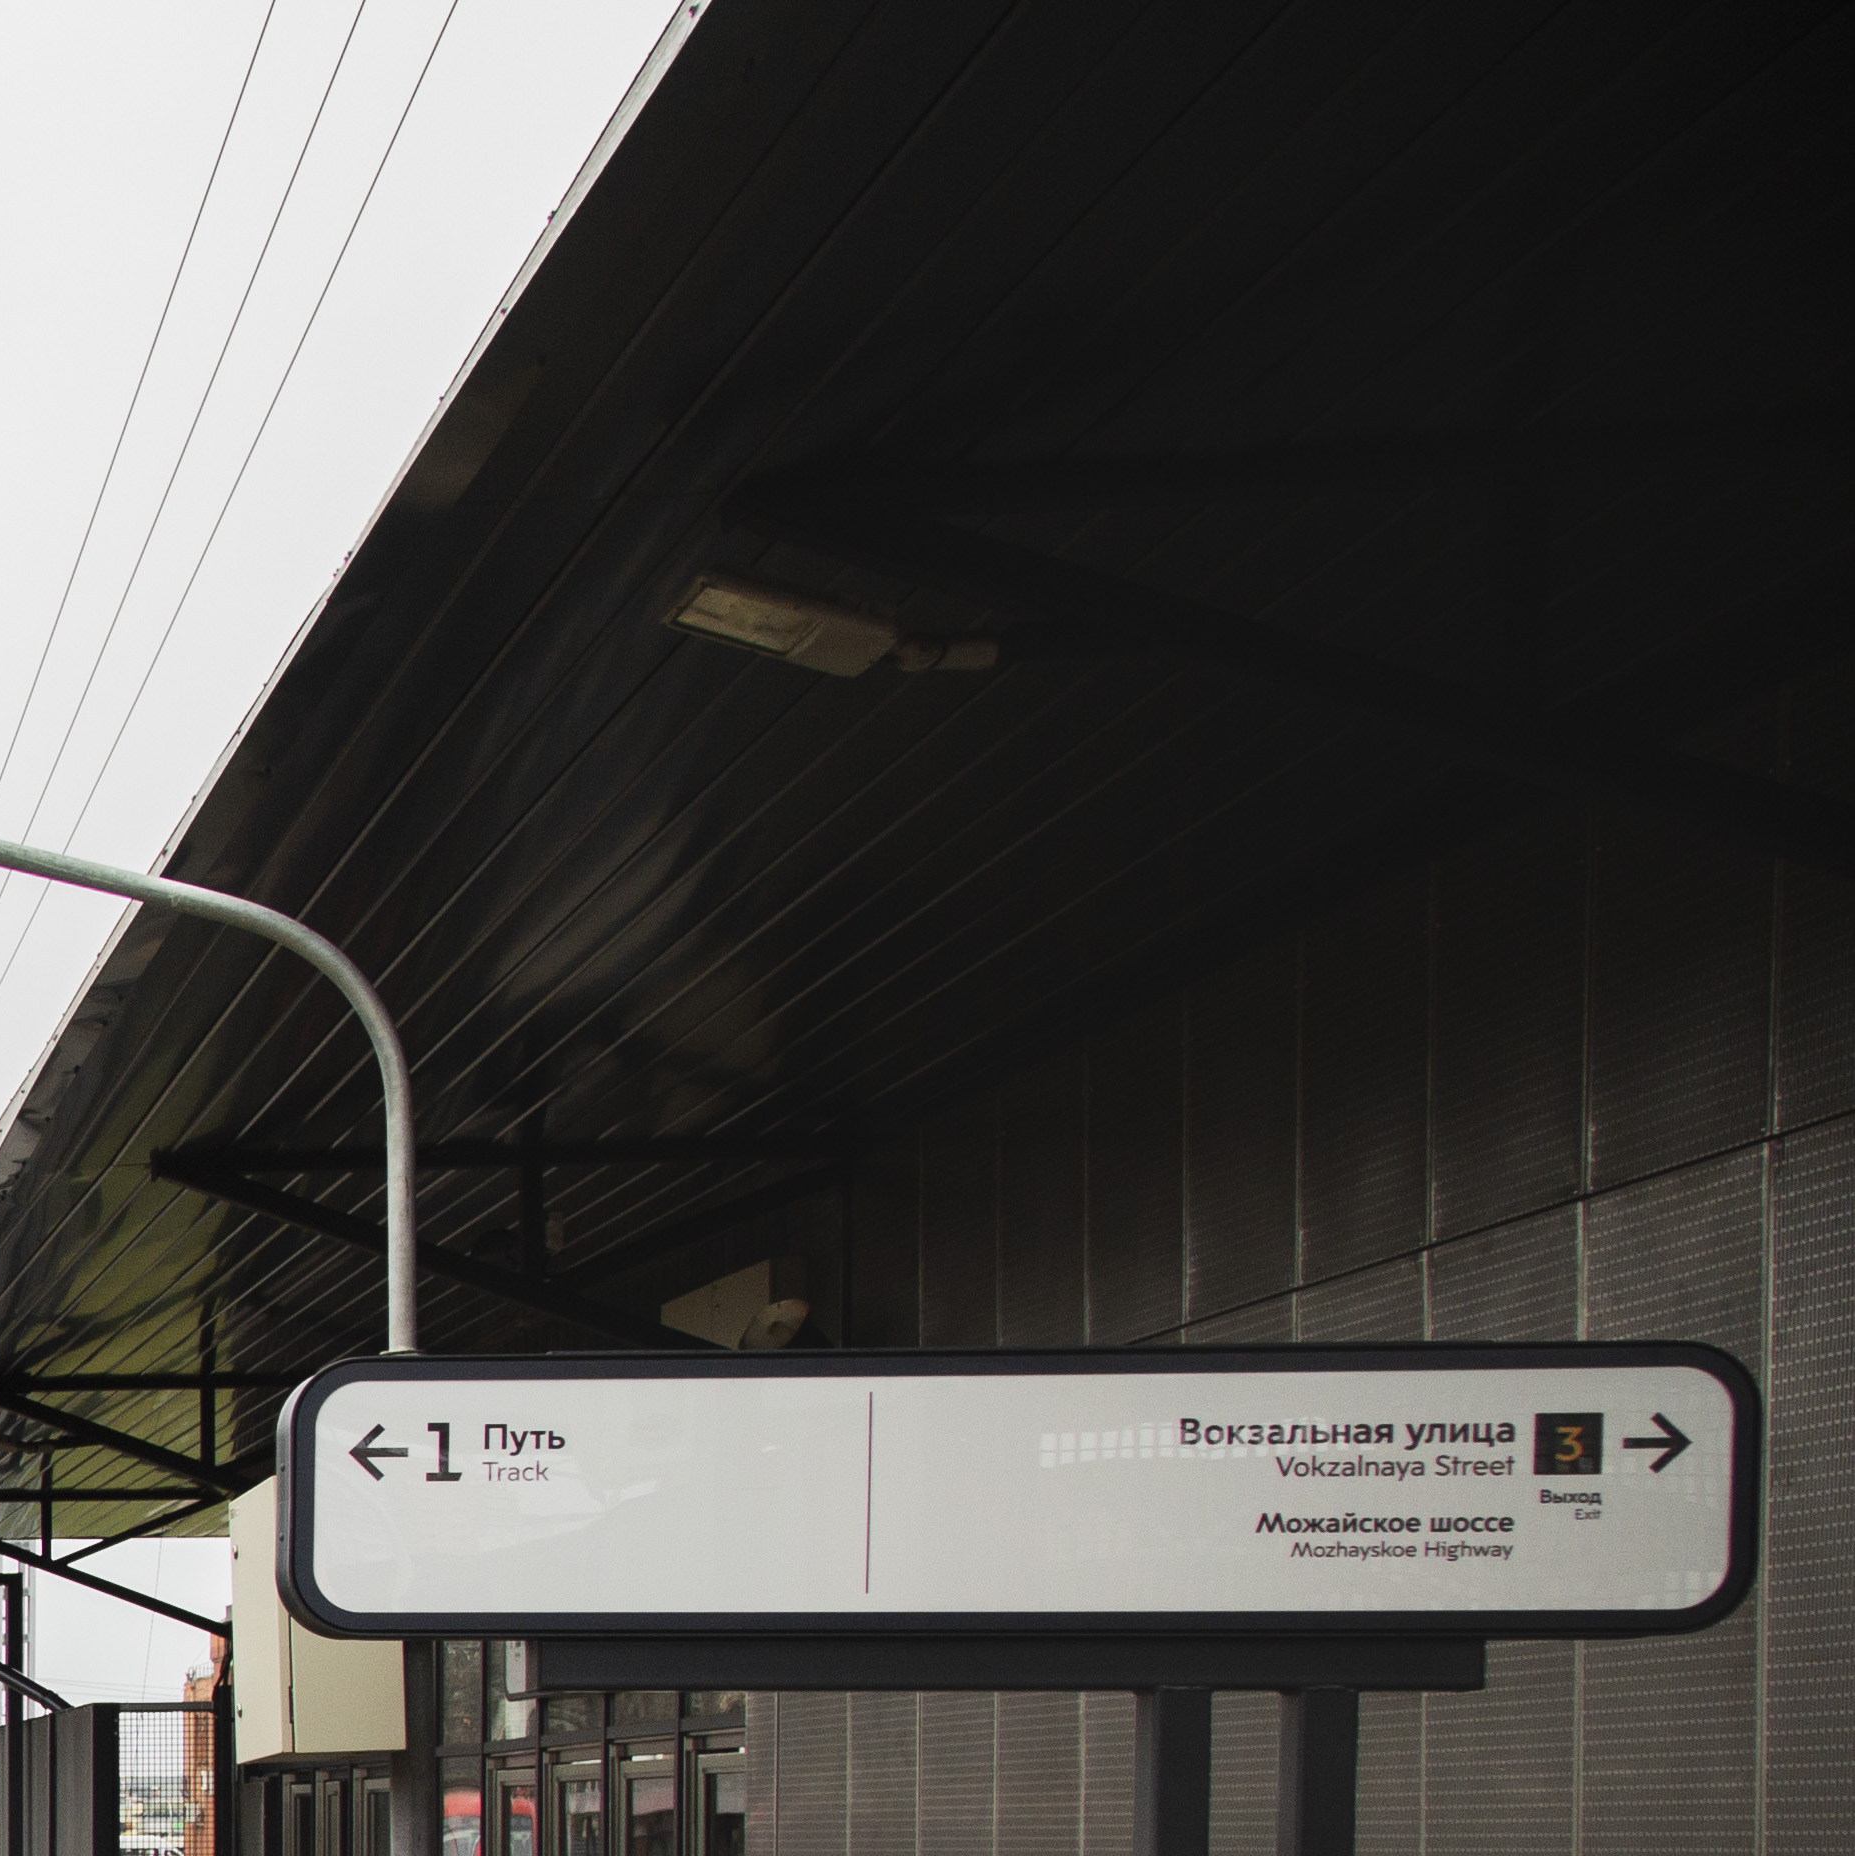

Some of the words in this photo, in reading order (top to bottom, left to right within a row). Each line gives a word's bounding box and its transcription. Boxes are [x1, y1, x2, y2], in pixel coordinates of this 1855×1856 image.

[484, 1423, 566, 1456] Путь
[1179, 1417, 1394, 1446] Вокзальная
[1405, 1420, 1516, 1450] улица
[1555, 1426, 1584, 1462] 3
[425, 1422, 463, 1482] 1
[482, 1460, 549, 1482] Track
[1275, 1456, 1426, 1482] Vokzalnaya
[1434, 1454, 1515, 1477] Street
[1539, 1489, 1602, 1506] Выход
[1255, 1513, 1421, 1534] Можайское
[1430, 1515, 1515, 1533] шоссе
[1575, 1508, 1601, 1520] Exit
[1290, 1541, 1418, 1561] Mozhayskoe
[1424, 1541, 1514, 1562] Highway
